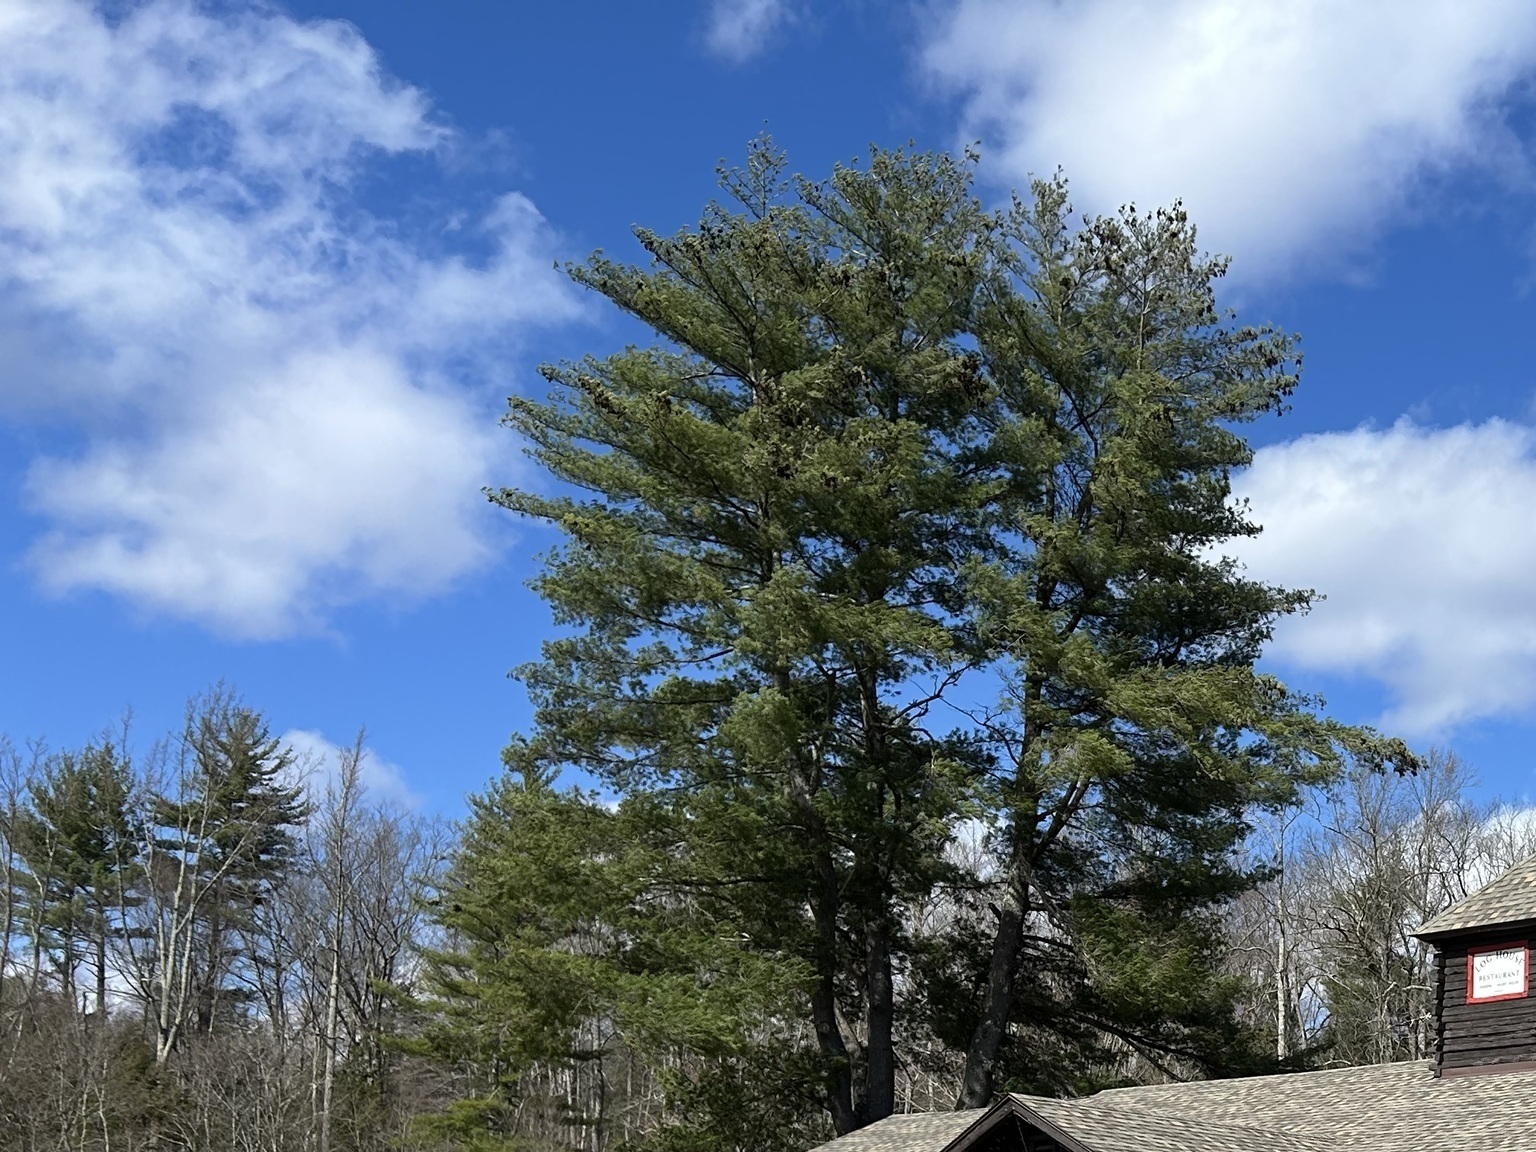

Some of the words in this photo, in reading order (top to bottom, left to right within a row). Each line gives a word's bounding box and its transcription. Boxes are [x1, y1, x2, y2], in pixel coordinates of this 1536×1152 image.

[1475, 955, 1492, 973] LOG
[1496, 951, 1525, 966] HOUSE
[1479, 969, 1520, 982] RESTAURANT
